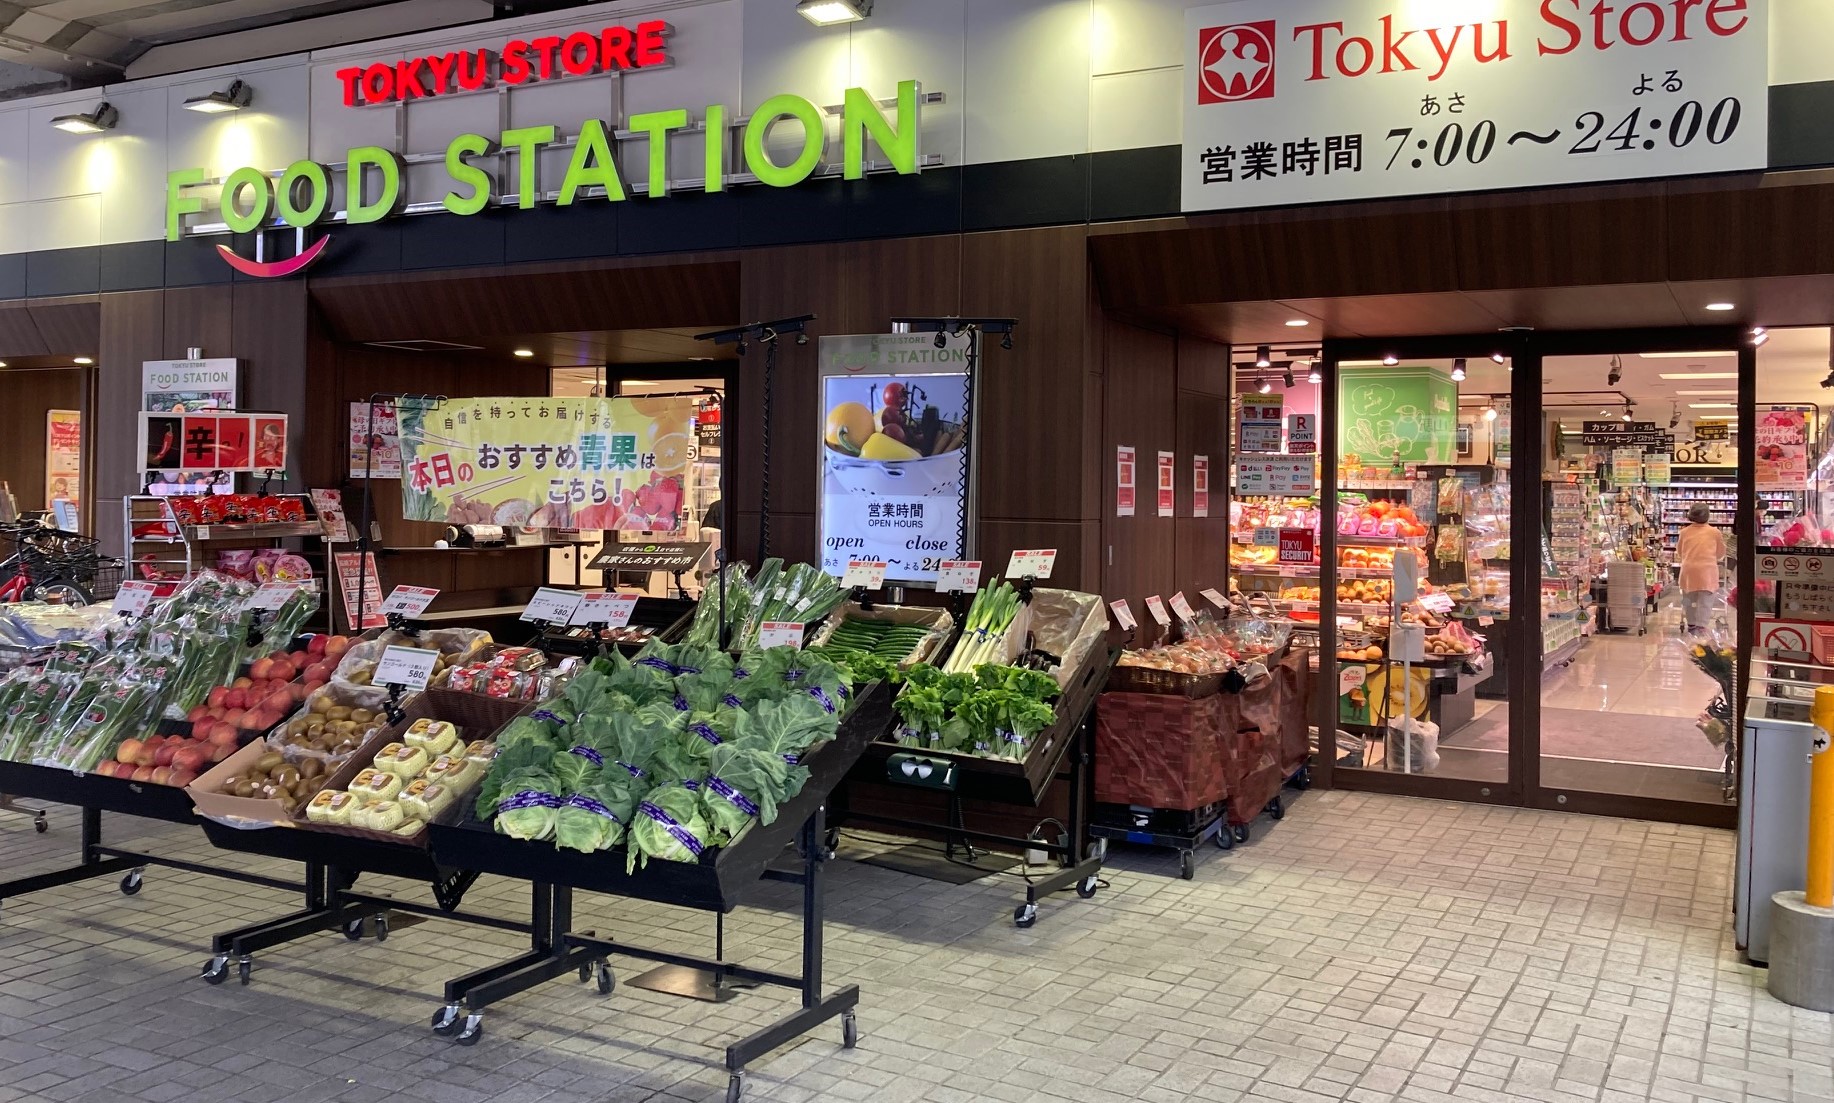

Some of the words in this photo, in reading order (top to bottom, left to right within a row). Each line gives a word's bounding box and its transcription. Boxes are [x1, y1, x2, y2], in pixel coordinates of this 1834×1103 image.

[1293, 16, 1512, 82] Tokyu
[1536, 0, 1749, 57] Store
[337, 48, 487, 107] TOKYU
[503, 20, 667, 84] STORE
[1631, 70, 1684, 97] よる
[1420, 92, 1466, 117] あさ
[167, 146, 402, 242] FOOD
[442, 80, 920, 217] STATION
[1200, 133, 1363, 186] 営業時間
[888, 348, 964, 363] STATION
[151, 373, 180, 384] FOOD
[183, 372, 229, 383] STATION
[444, 404, 612, 431] 自信を持ってお届けする
[409, 453, 474, 492] 本日の
[478, 434, 656, 471] おすすめ青果は
[868, 503, 924, 519] 営業時間
[868, 519, 891, 528] OPEN
[894, 520, 924, 529] HOURS
[826, 536, 865, 551] open
[905, 535, 949, 551] close
[1281, 540, 1302, 550] TOKYU
[1281, 550, 1312, 561] SECURITY
